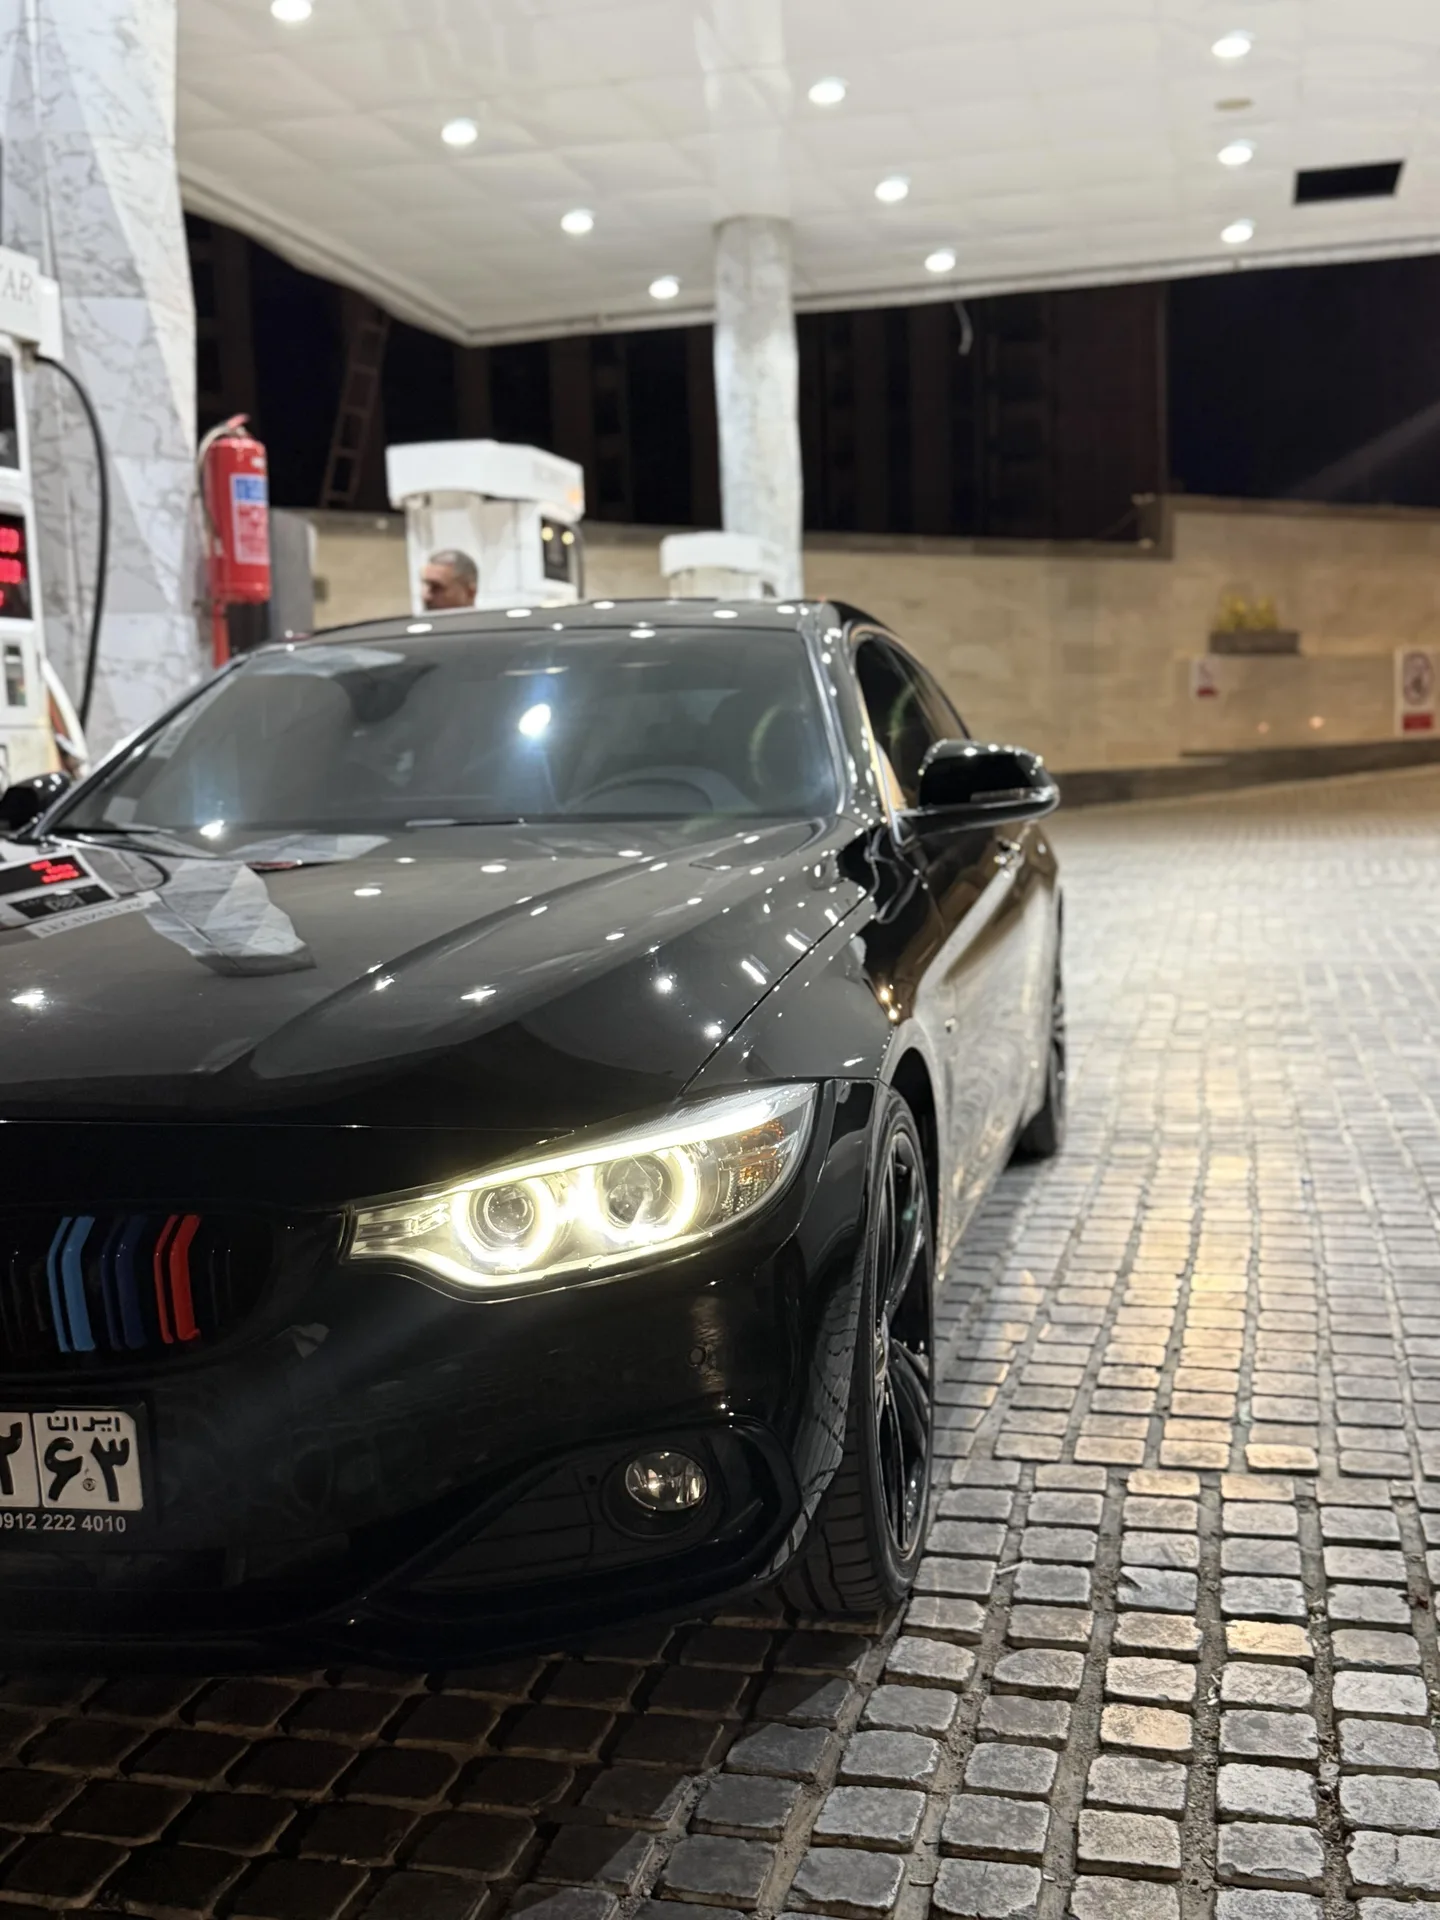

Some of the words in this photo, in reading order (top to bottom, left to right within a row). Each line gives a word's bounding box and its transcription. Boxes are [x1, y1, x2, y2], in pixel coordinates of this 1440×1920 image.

[0, 263, 33, 304] AR
[47, 1416, 121, 1432] ایران
[44, 1436, 130, 1502] ۶۳
[0, 1513, 37, 1530] 912
[42, 1514, 76, 1531] 222
[82, 1515, 126, 1533] 4010
